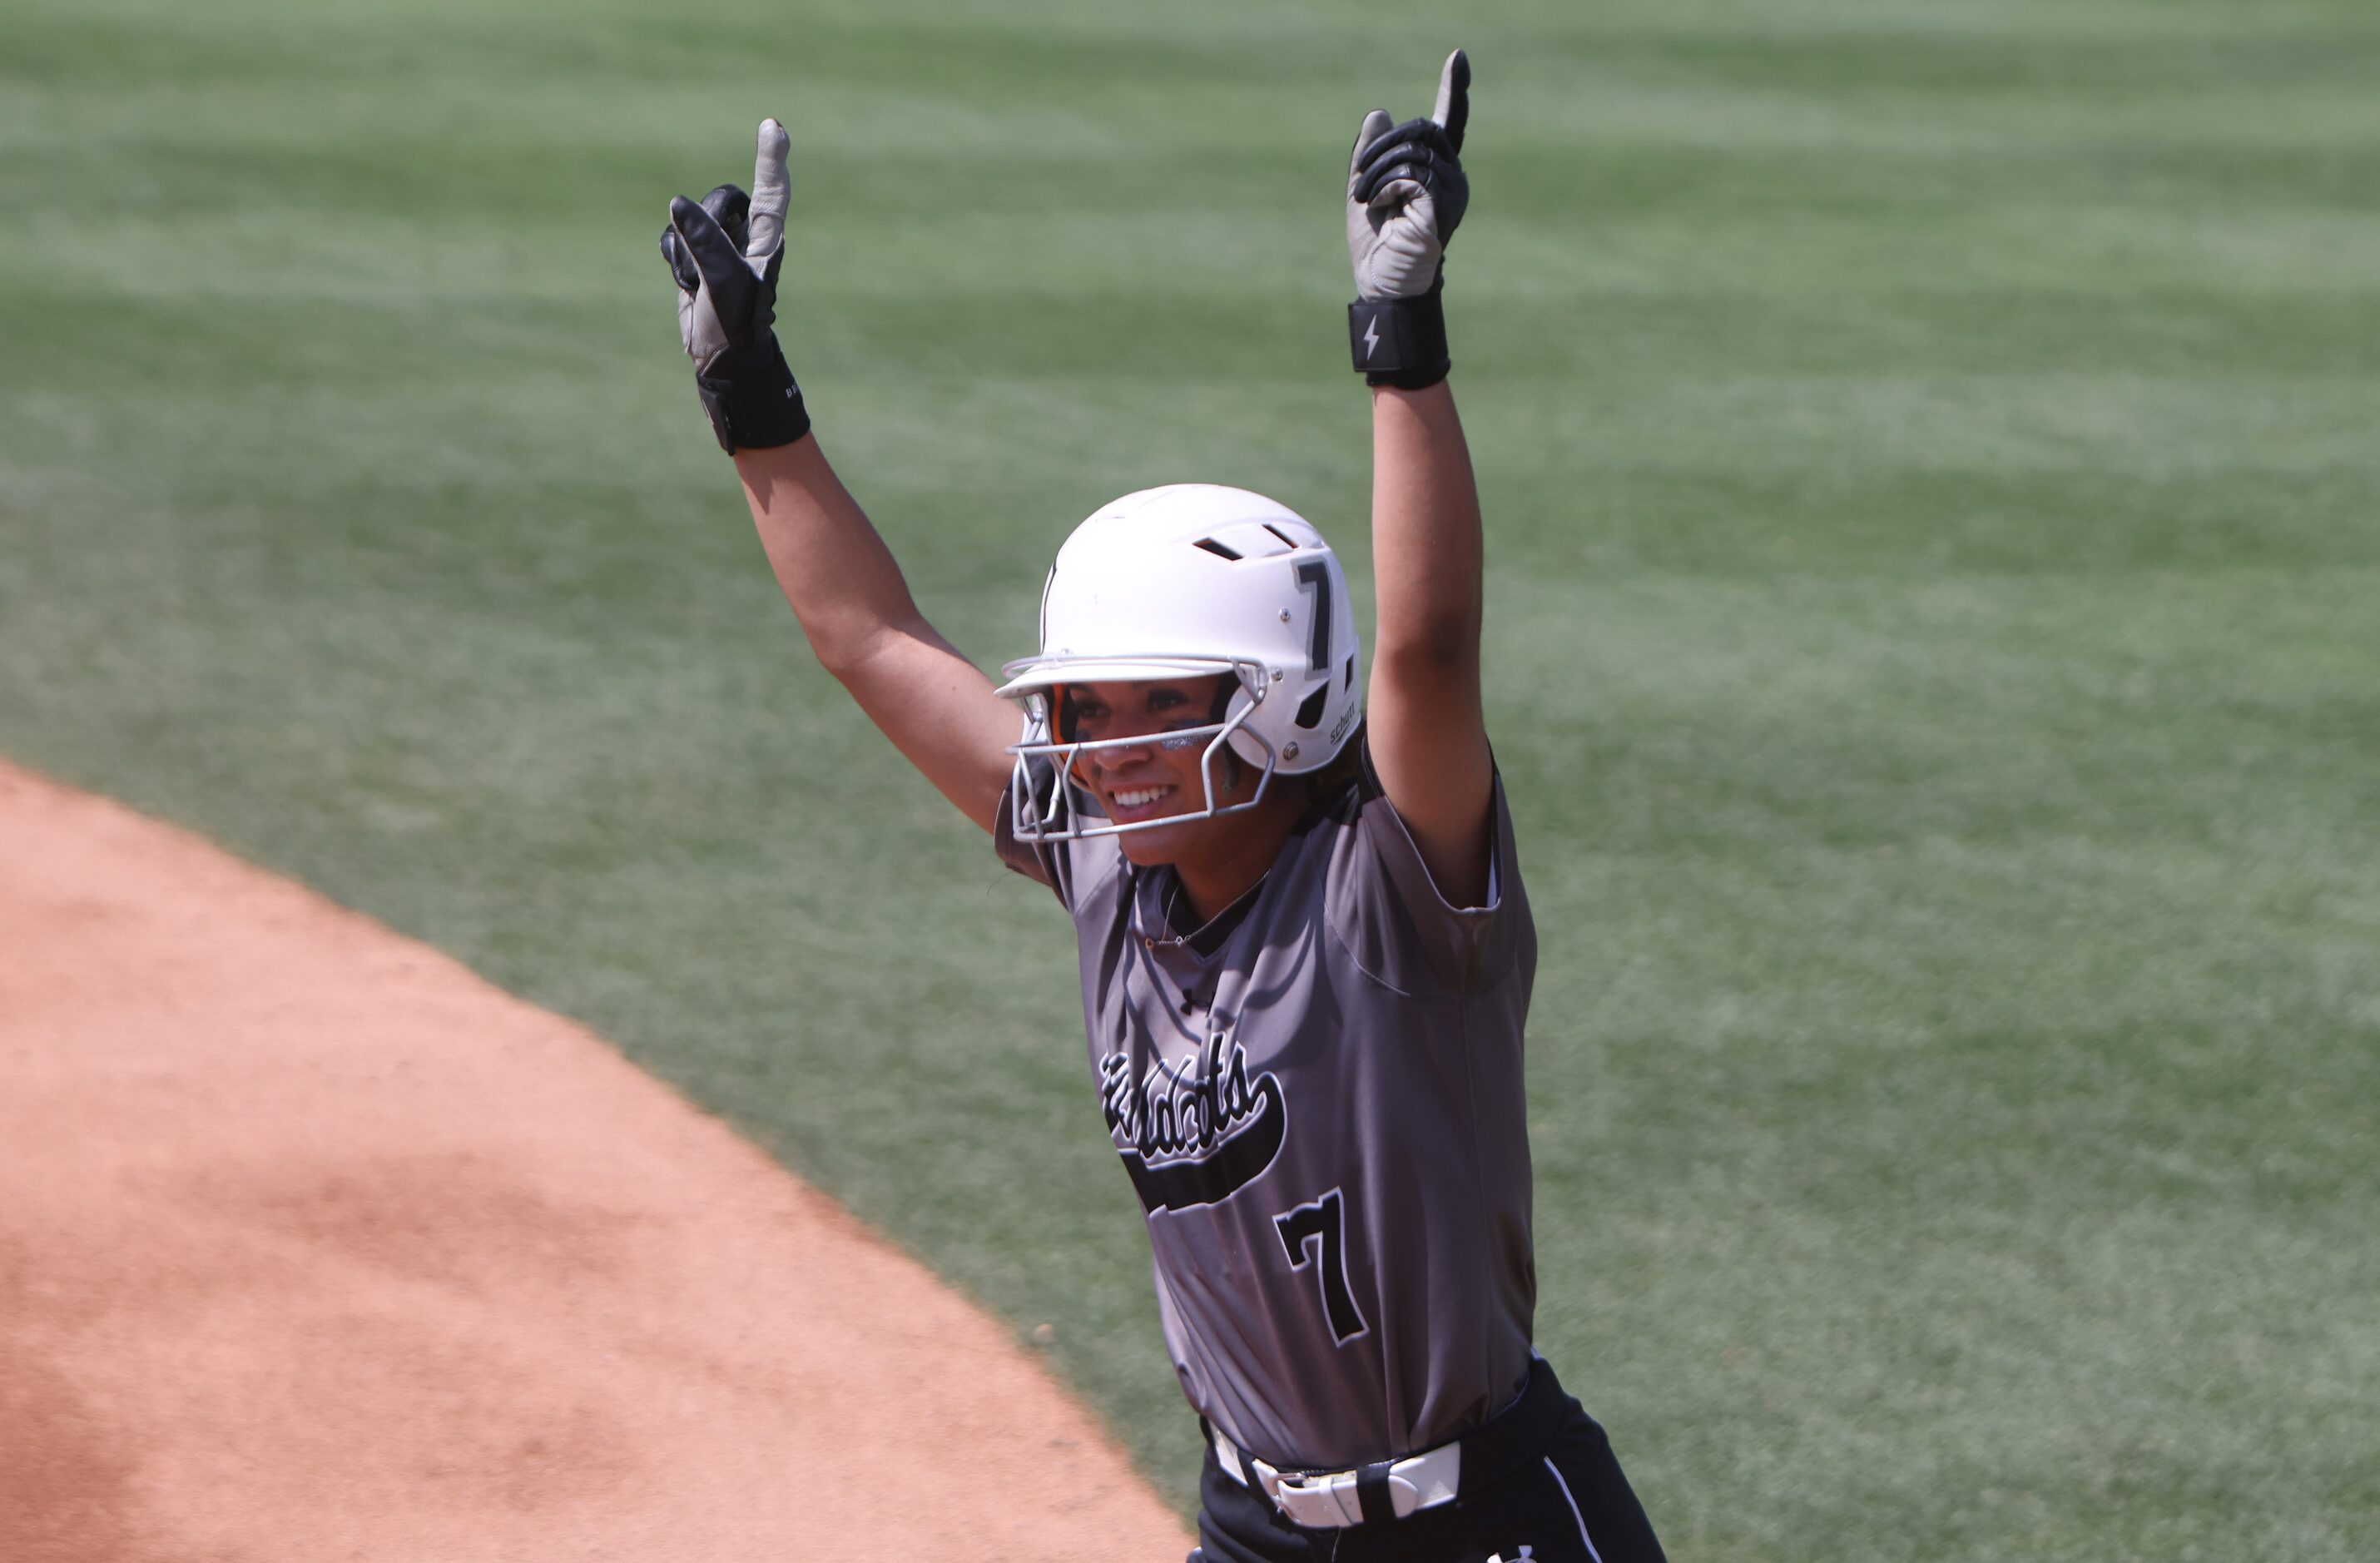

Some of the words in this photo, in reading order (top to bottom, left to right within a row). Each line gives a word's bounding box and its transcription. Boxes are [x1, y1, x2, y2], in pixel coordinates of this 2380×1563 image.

[1291, 554, 1333, 681] 7
[1330, 701, 1355, 745] schutt
[1272, 1185, 1370, 1347] 7
